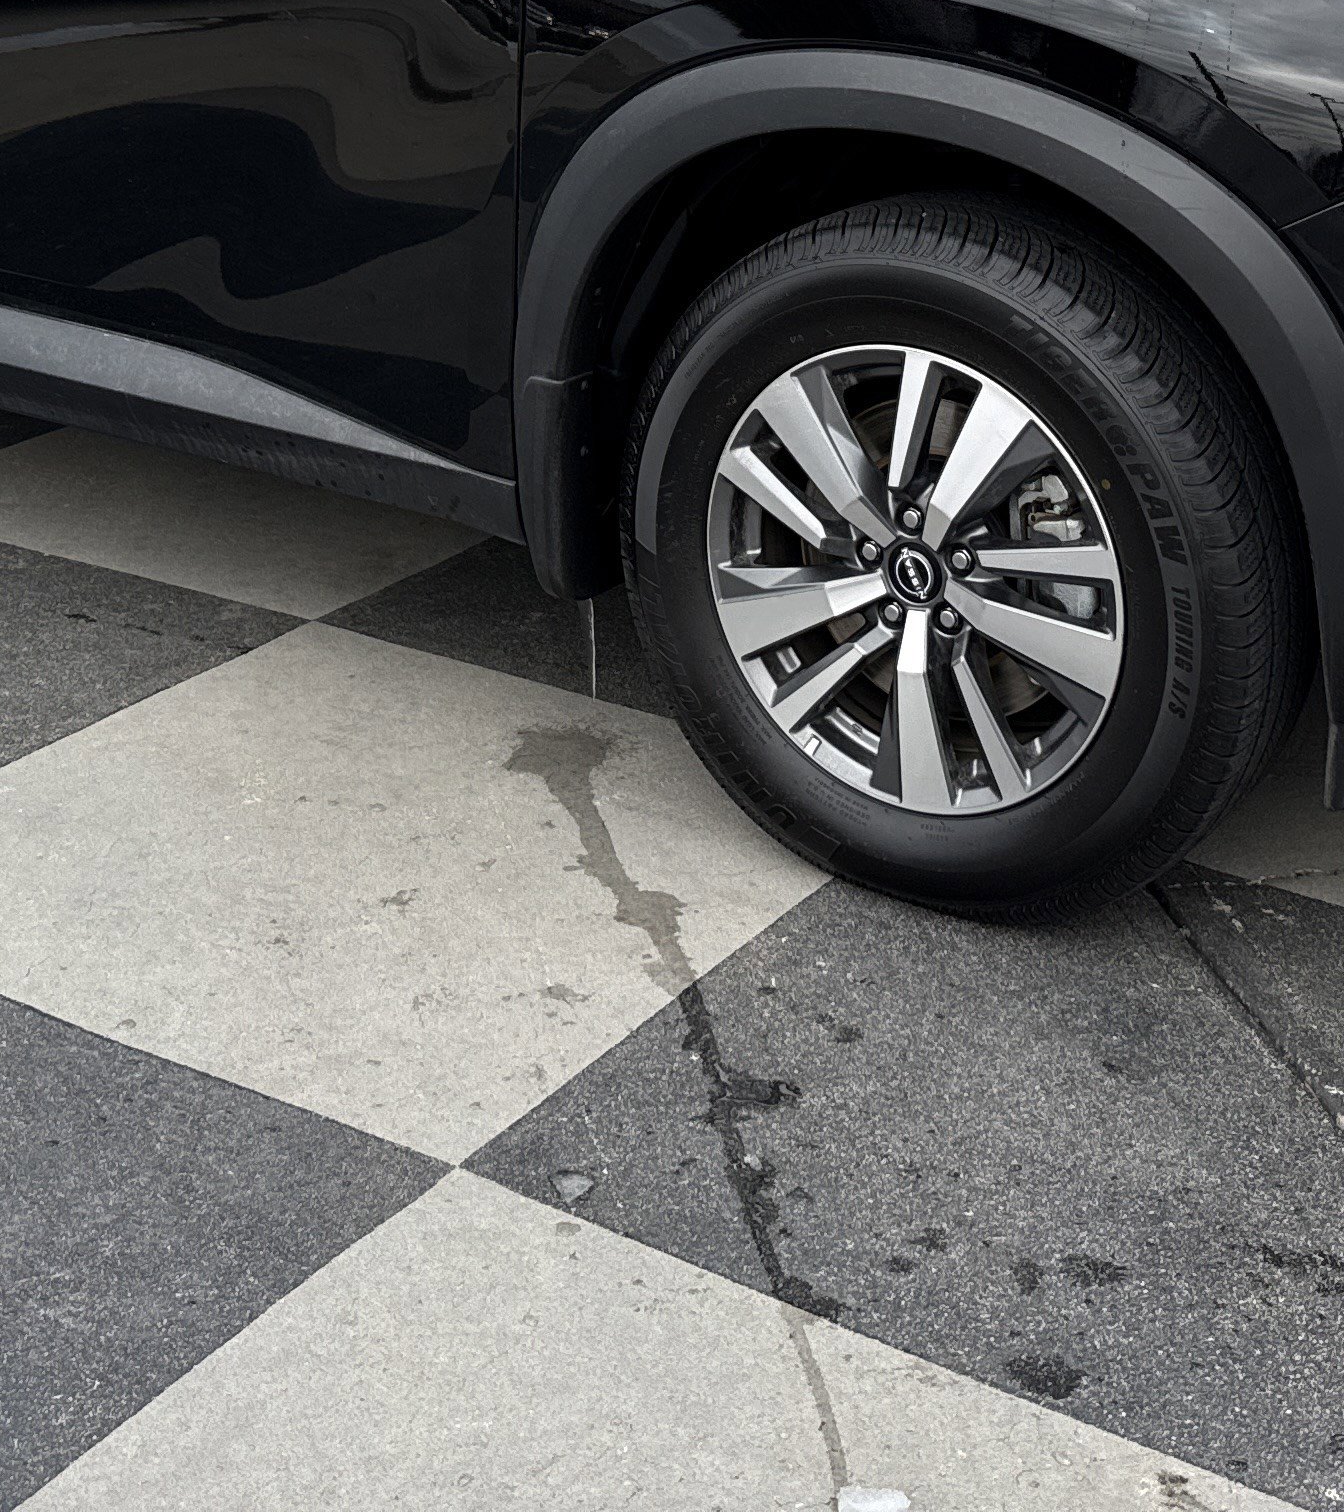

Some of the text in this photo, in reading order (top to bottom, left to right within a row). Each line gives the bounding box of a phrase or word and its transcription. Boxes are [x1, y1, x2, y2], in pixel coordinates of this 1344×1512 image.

[1125, 461, 1189, 566] PAW
[901, 547, 928, 600] NISSAN
[1167, 586, 1194, 719] TOURING A/S
